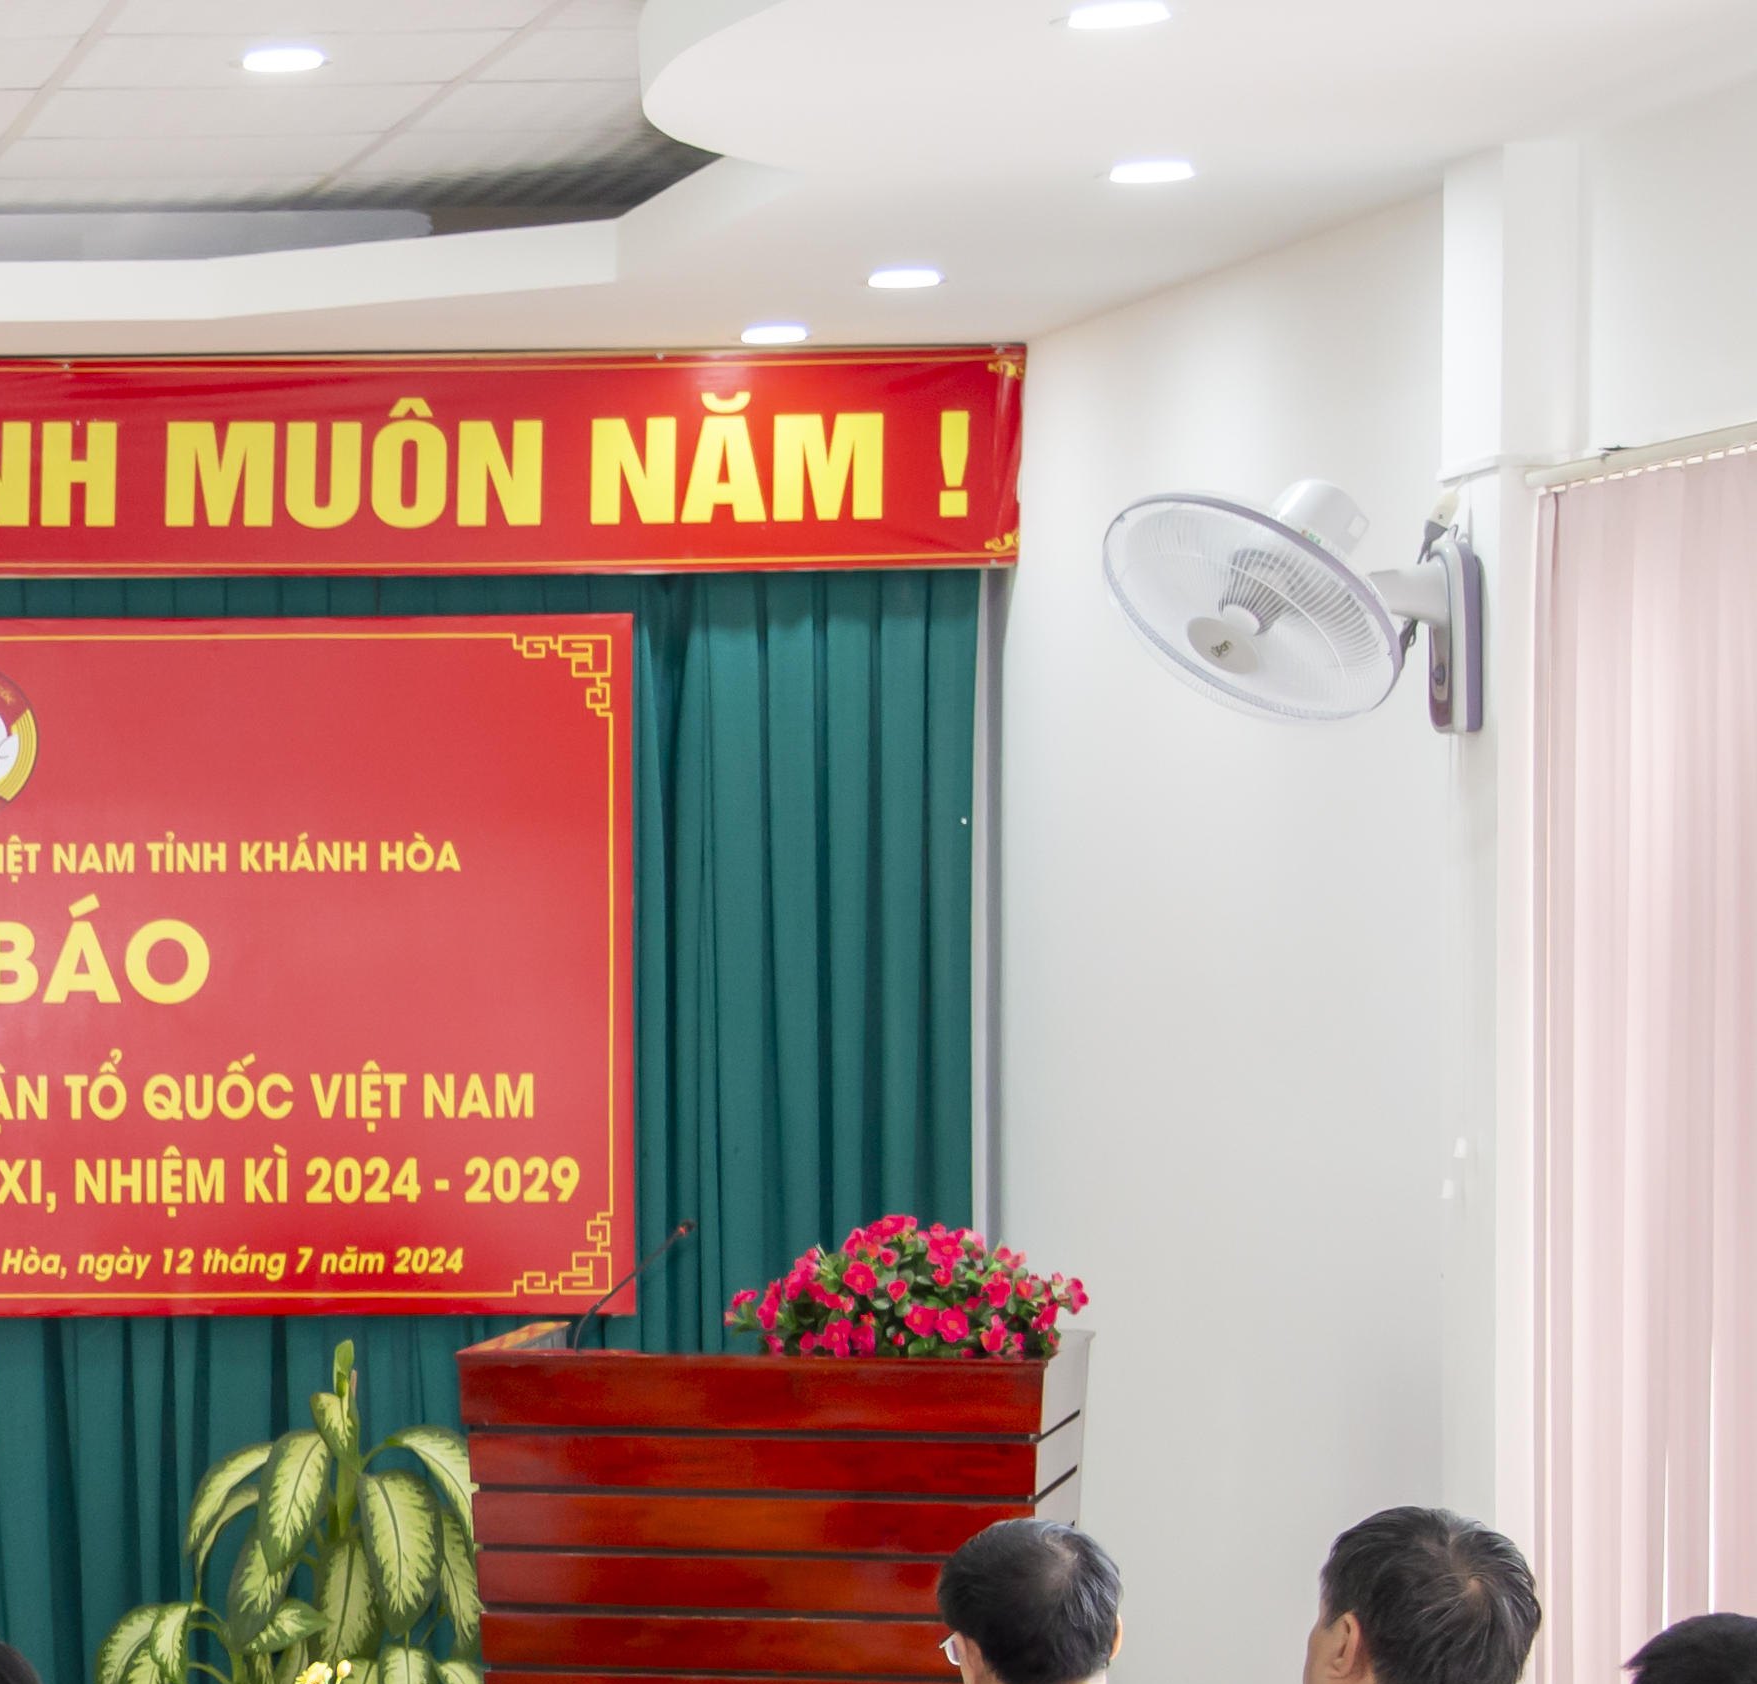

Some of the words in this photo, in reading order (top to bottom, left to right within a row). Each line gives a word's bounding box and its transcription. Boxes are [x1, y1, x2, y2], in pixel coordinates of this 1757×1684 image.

[165, 398, 543, 528] MUÔN
[590, 390, 884, 524] NĂM
[939, 410, 970, 518] !
[53, 842, 135, 874] NAM
[147, 831, 227, 873] TỈNH
[240, 832, 368, 873] KHÁNH
[380, 831, 462, 873] HÒA
[64, 1047, 128, 1121] TỔ
[142, 1053, 294, 1122] QUỐC
[310, 1059, 409, 1132] VIỆT
[423, 1072, 535, 1120] NAM
[74, 1144, 226, 1219] NHIỆM
[243, 1142, 289, 1204] KÌ
[304, 1155, 422, 1206] 2024
[463, 1155, 581, 1205] 2029
[0, 1245, 68, 1280] Hòa,
[76, 1245, 153, 1283] ngày
[162, 1246, 196, 1276] 12
[201, 1244, 288, 1283] tháng
[295, 1245, 316, 1275] 7
[319, 1245, 386, 1275] năm
[391, 1245, 465, 1275] 2024
